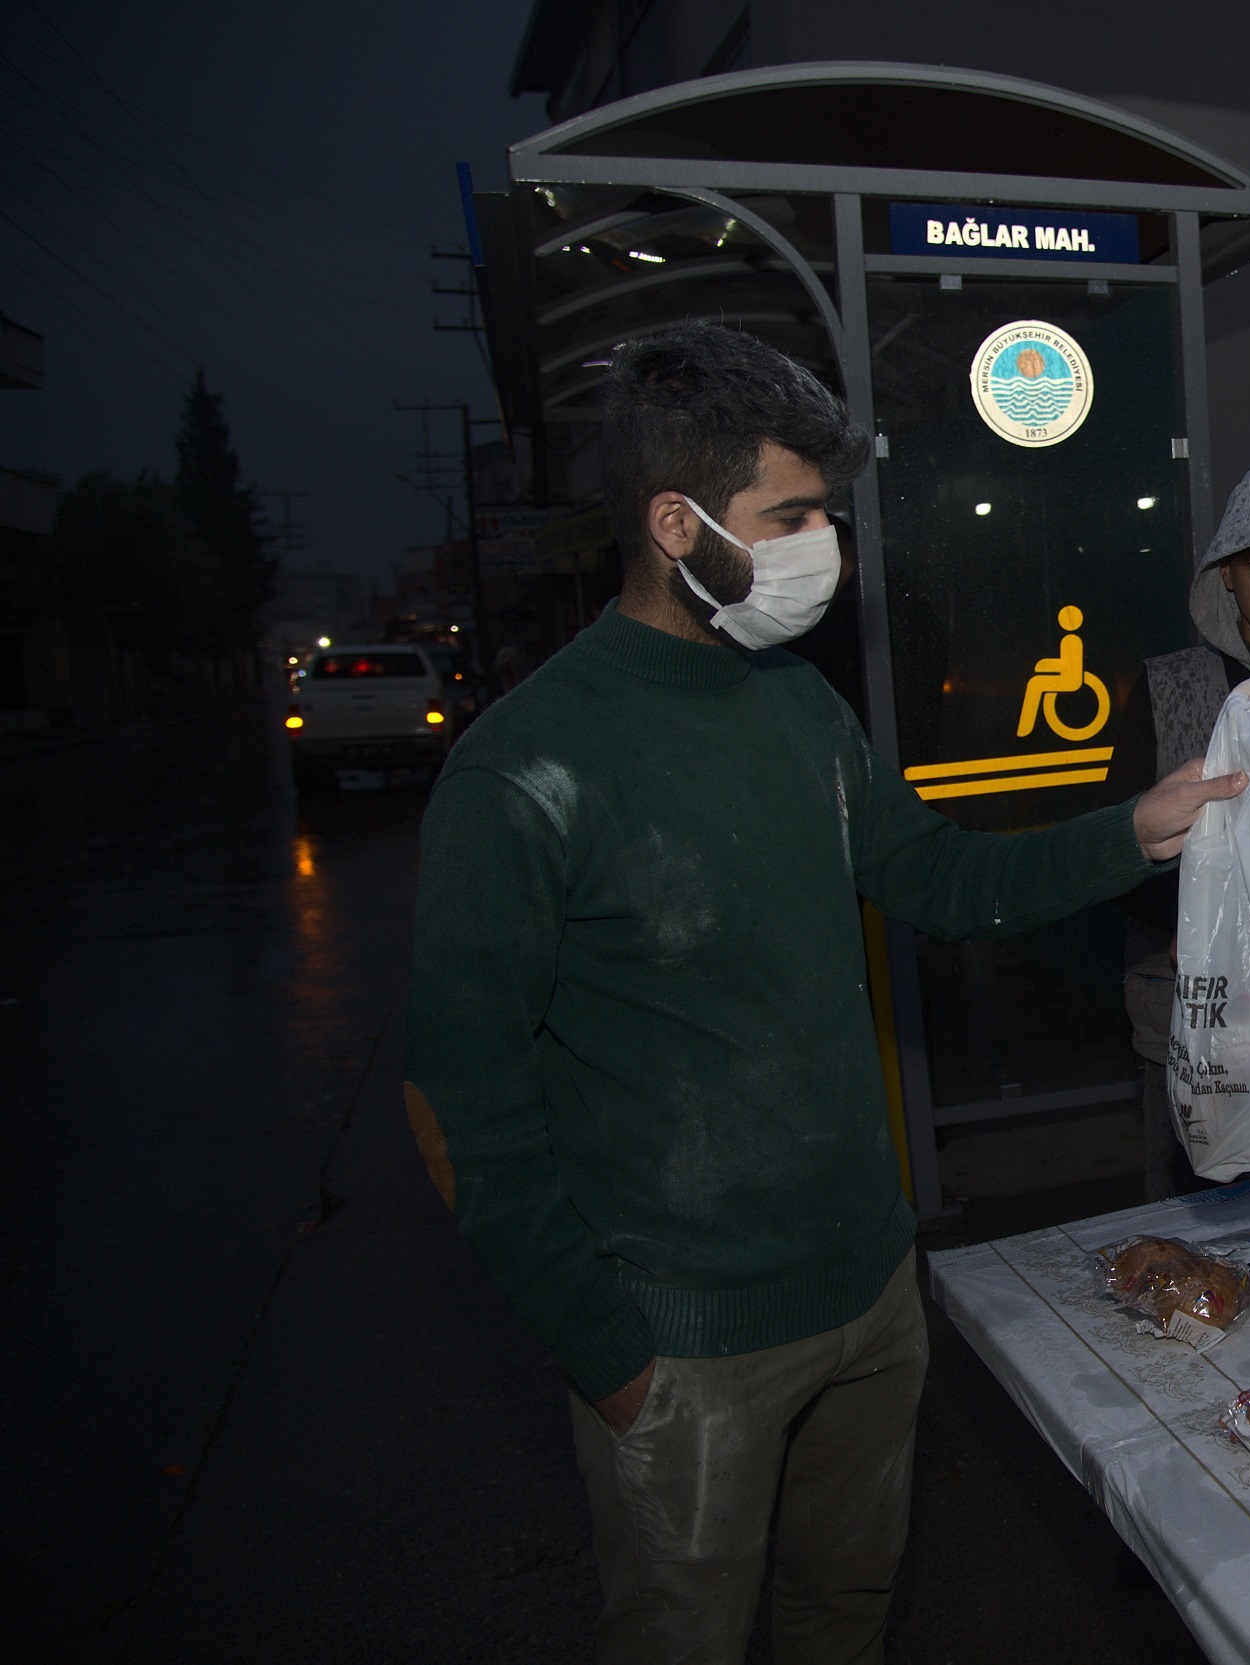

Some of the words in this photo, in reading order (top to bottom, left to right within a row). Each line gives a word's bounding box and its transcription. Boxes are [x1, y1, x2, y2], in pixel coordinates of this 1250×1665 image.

[926, 217, 1030, 249] BAĞLAR
[1034, 226, 1096, 252] MAH.
[981, 354, 994, 393] MERSİN
[992, 331, 1052, 355] BÜYÜKŞEHİR
[1052, 339, 1084, 392] BELEDİYESİ
[1024, 427, 1049, 439] 1873
[1182, 975, 1229, 1000] IFIR
[1185, 1002, 1228, 1029] TIK
[1213, 1080, 1250, 1098] Kaçının.
